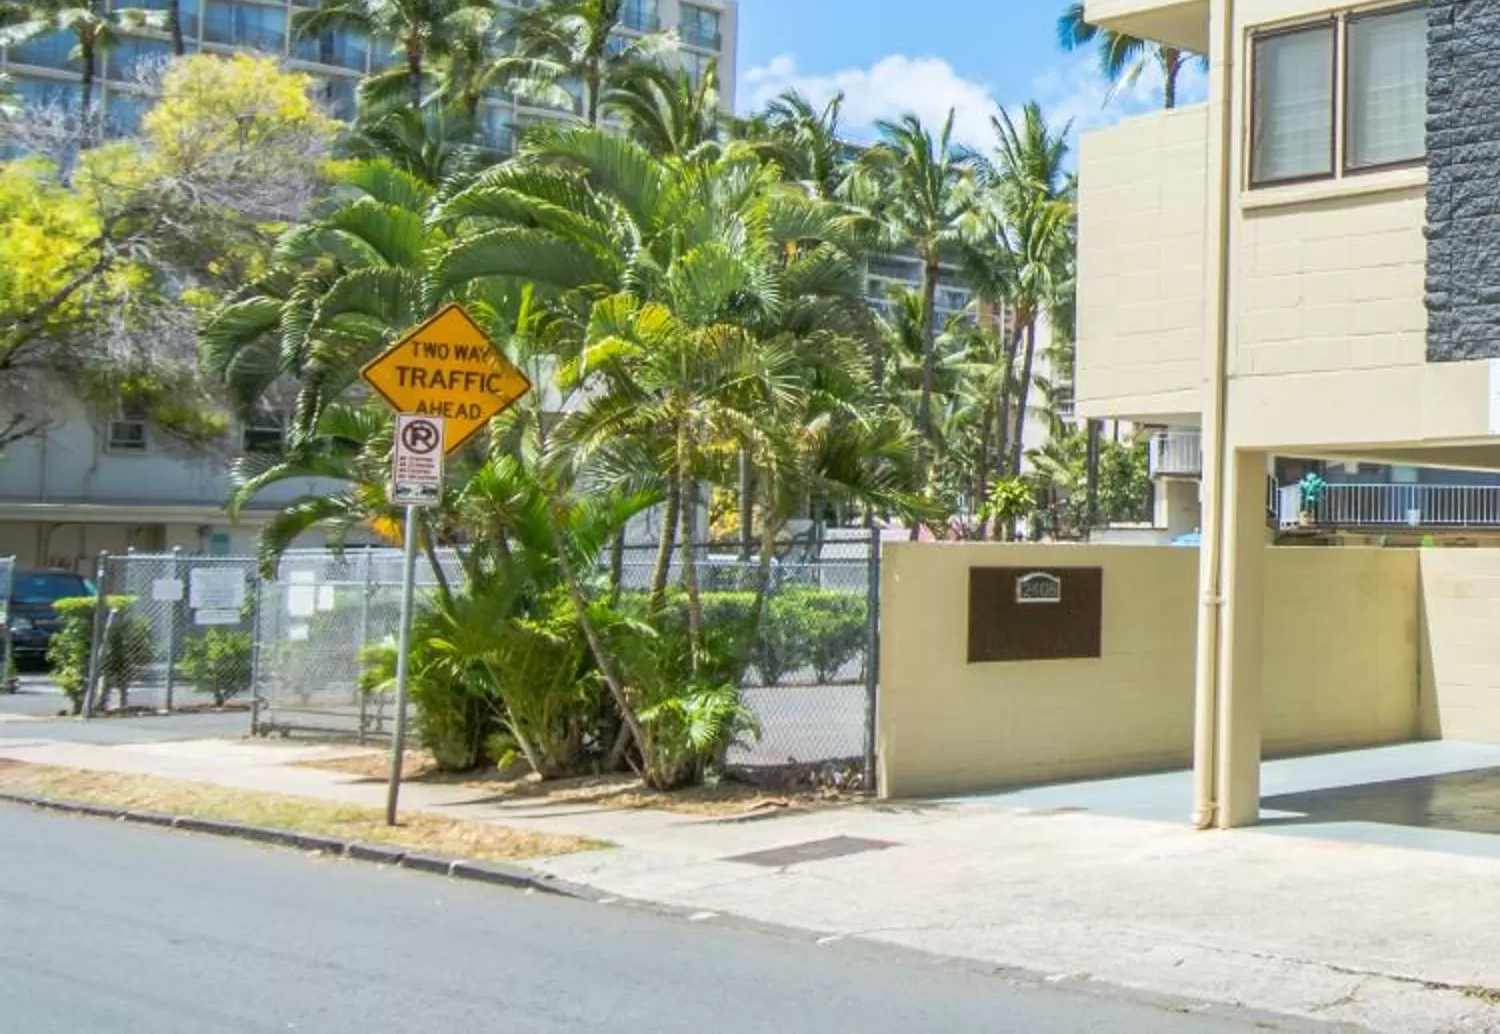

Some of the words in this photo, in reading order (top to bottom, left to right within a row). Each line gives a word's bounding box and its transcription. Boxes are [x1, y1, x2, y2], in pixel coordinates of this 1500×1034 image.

[412, 341, 449, 361] TWO
[453, 345, 489, 363] WAY
[395, 365, 501, 393] TRAFFIC
[415, 400, 482, 419] AHEAD
